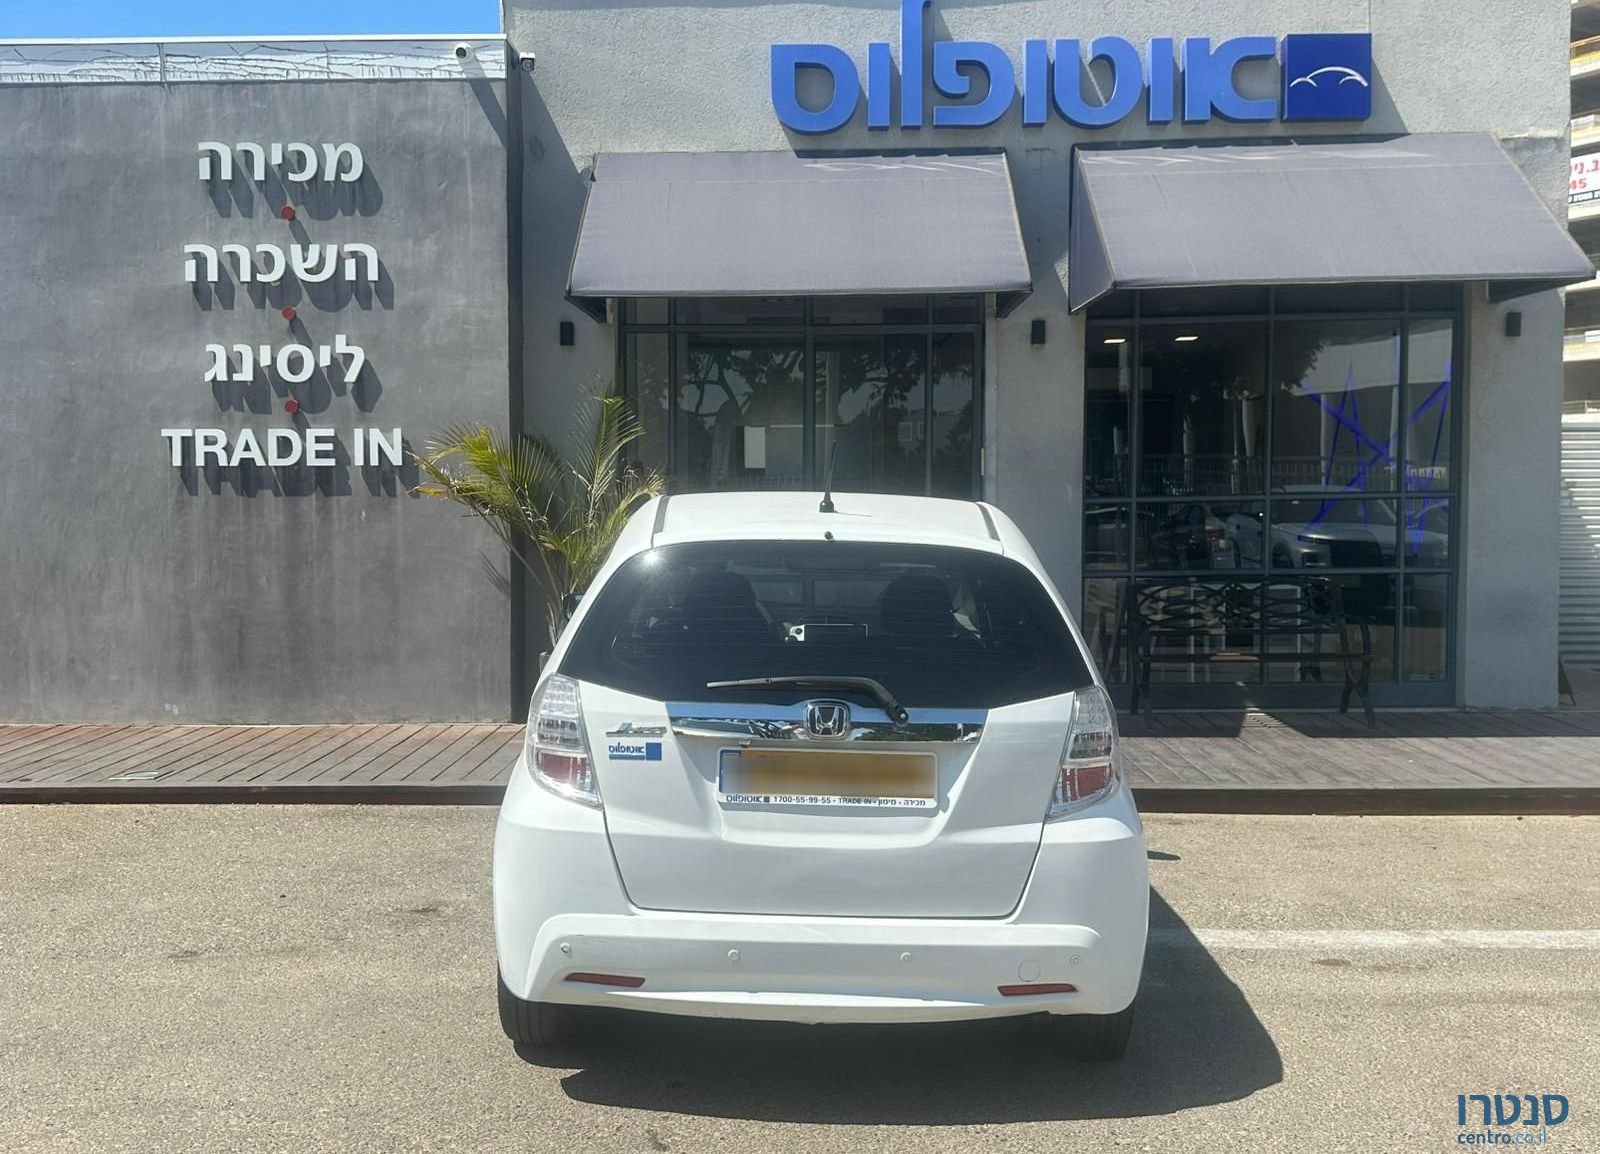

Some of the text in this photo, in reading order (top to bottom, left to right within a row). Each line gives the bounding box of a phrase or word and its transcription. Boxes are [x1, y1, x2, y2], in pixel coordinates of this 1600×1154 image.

[771, 0, 1277, 131] אוטופלוס
[198, 141, 364, 182] מכירה
[183, 243, 379, 283] השכרה
[204, 334, 366, 383] ליסינג
[161, 428, 403, 466] TRADE IN
[774, 795, 831, 804] 1700-55-99-55
